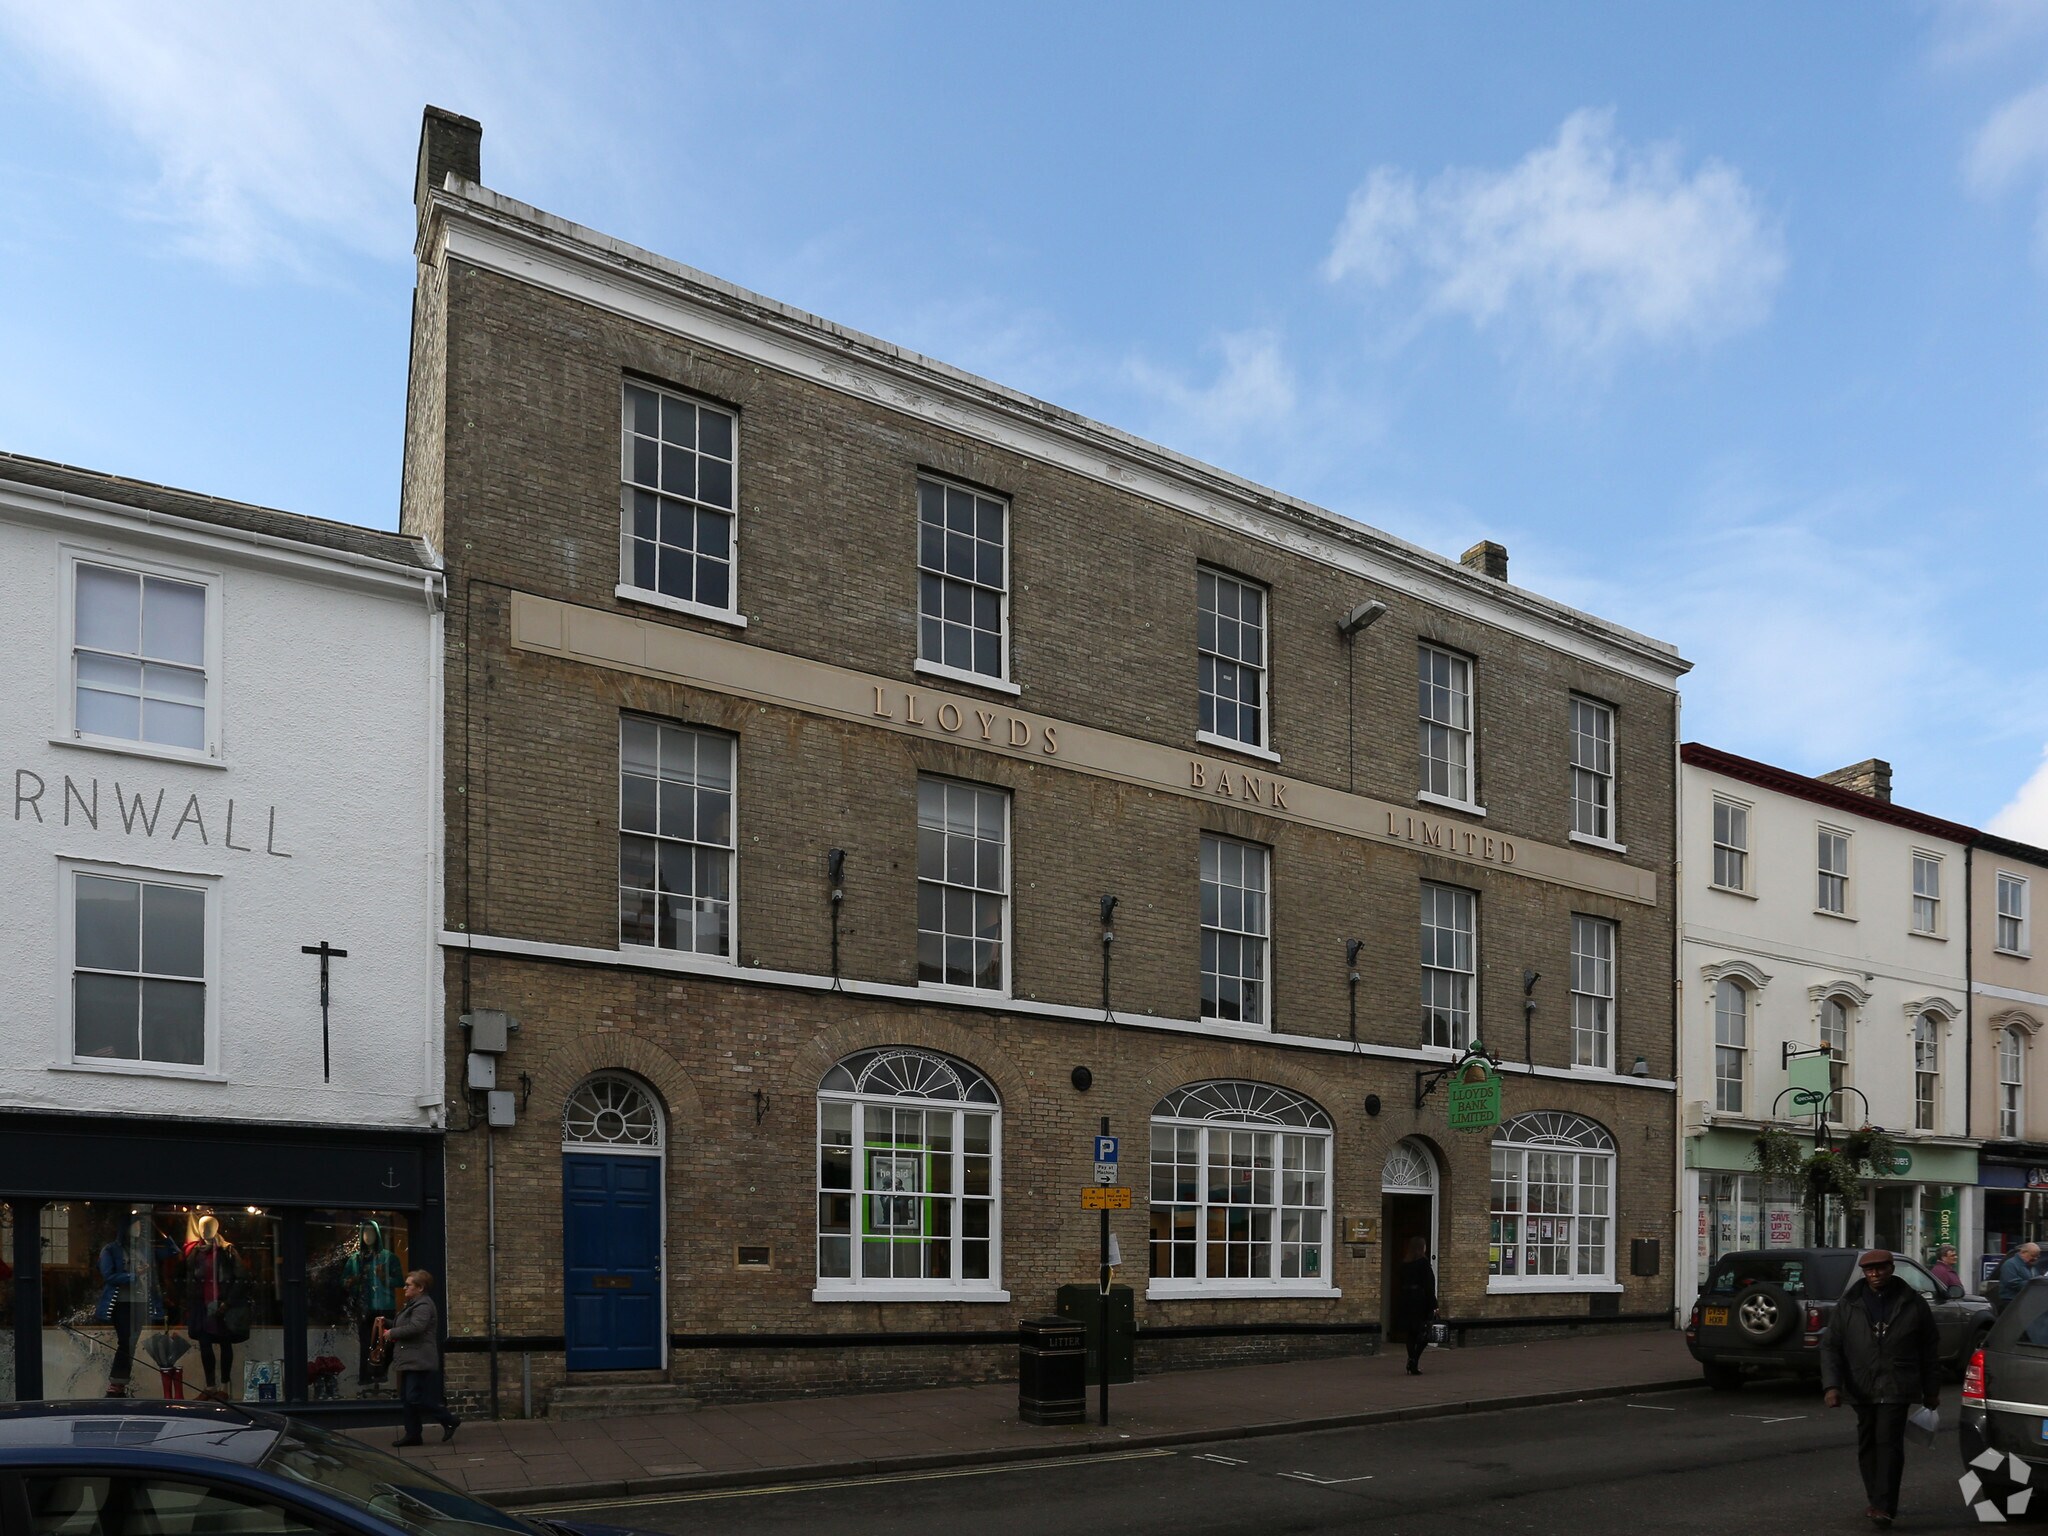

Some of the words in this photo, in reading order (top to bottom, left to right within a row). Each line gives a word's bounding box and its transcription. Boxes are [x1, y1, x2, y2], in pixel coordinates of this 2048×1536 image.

[874, 686, 1058, 754] LLOYDS
[1190, 760, 1289, 809] BANK
[1387, 812, 1516, 864] LIMITED
[14, 769, 292, 858] RNWALL
[1453, 1087, 1494, 1101] LLOYDS
[1458, 1100, 1488, 1112] BANK
[1451, 1111, 1494, 1124] LIMITED
[1100, 1139, 1114, 1160] P
[1771, 1213, 1790, 1222] SAVE
[1771, 1223, 1782, 1231] UP
[1783, 1223, 1793, 1231] TO
[1941, 1209, 1952, 1240] Contact
[1771, 1232, 1791, 1240] £250
[1049, 1337, 1080, 1347] LITTER
